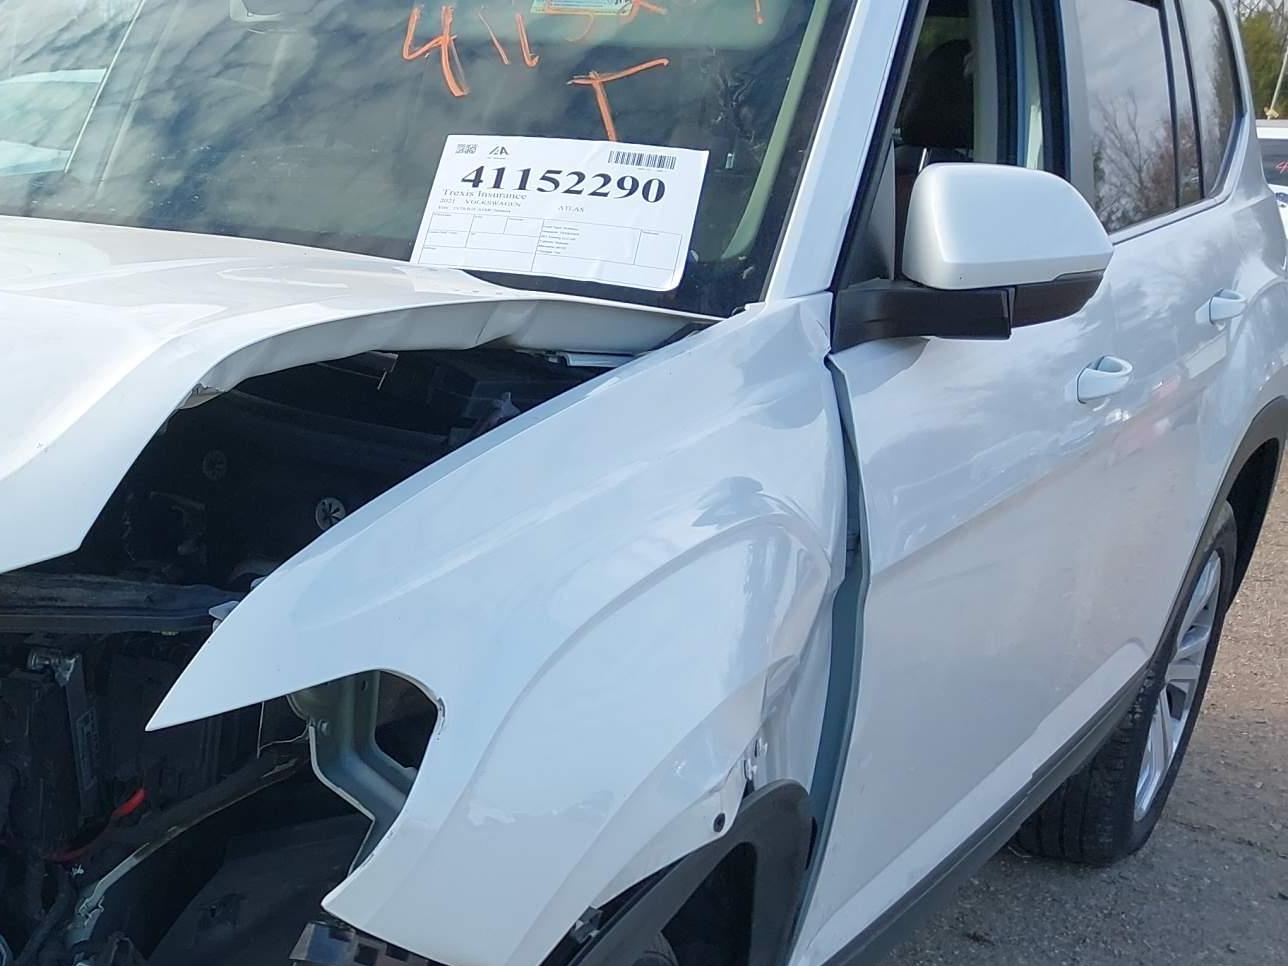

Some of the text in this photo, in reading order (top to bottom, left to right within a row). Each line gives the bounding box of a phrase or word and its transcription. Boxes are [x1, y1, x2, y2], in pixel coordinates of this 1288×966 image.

[443, 188, 528, 200] Trexis Insurance
[460, 165, 666, 204] 41152290
